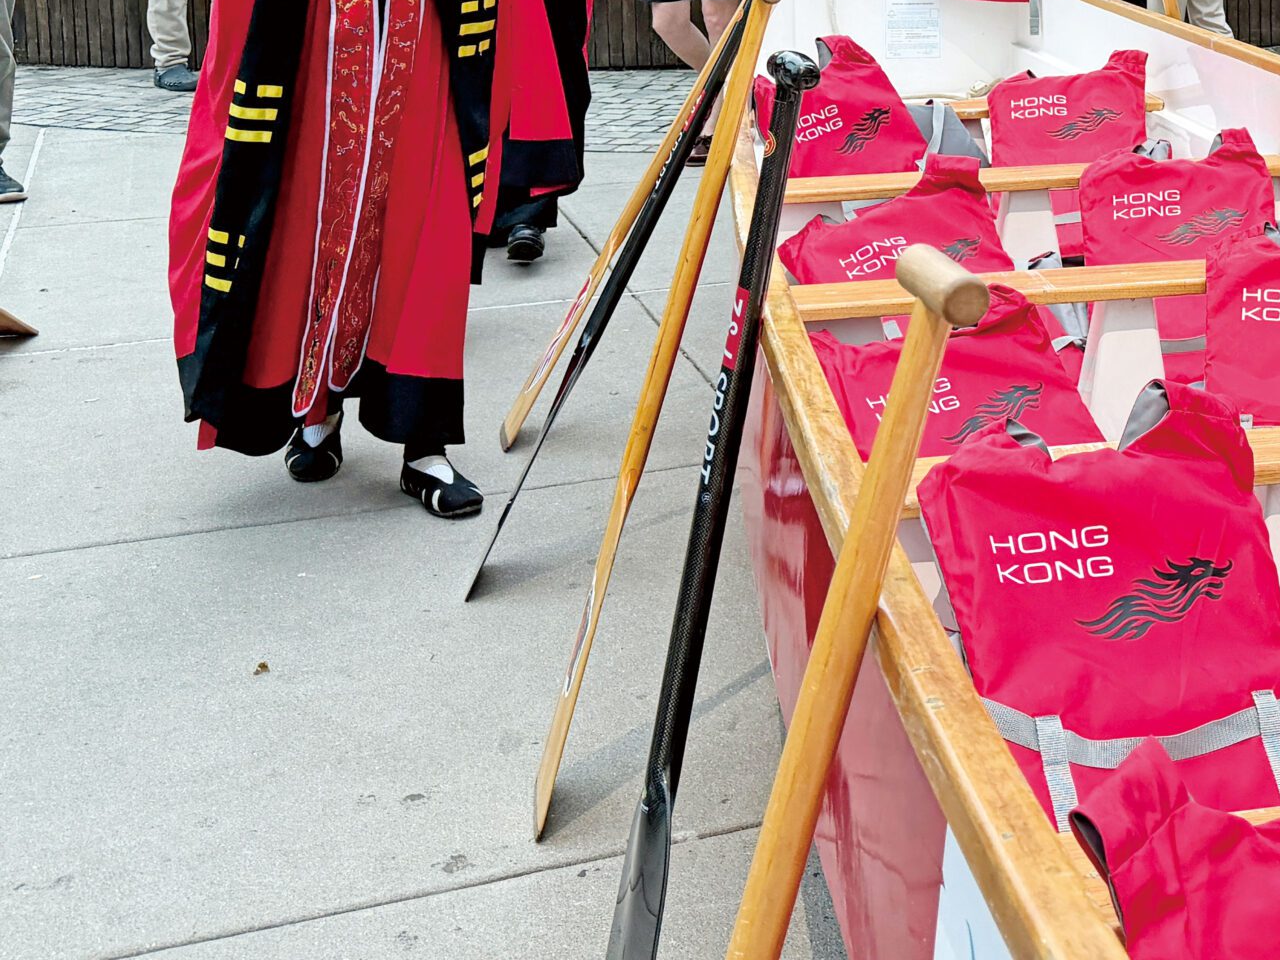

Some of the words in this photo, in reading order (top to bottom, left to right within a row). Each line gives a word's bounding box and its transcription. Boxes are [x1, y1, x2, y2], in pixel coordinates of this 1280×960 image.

[1010, 94, 1067, 108] HONG
[1010, 106, 1068, 120] KONG
[794, 117, 843, 144] KONG
[1112, 189, 1181, 206] HONG
[1113, 204, 1182, 221] KONG
[838, 235, 907, 268] HONG
[988, 524, 1109, 555] HONG
[996, 556, 1115, 585] KONG
